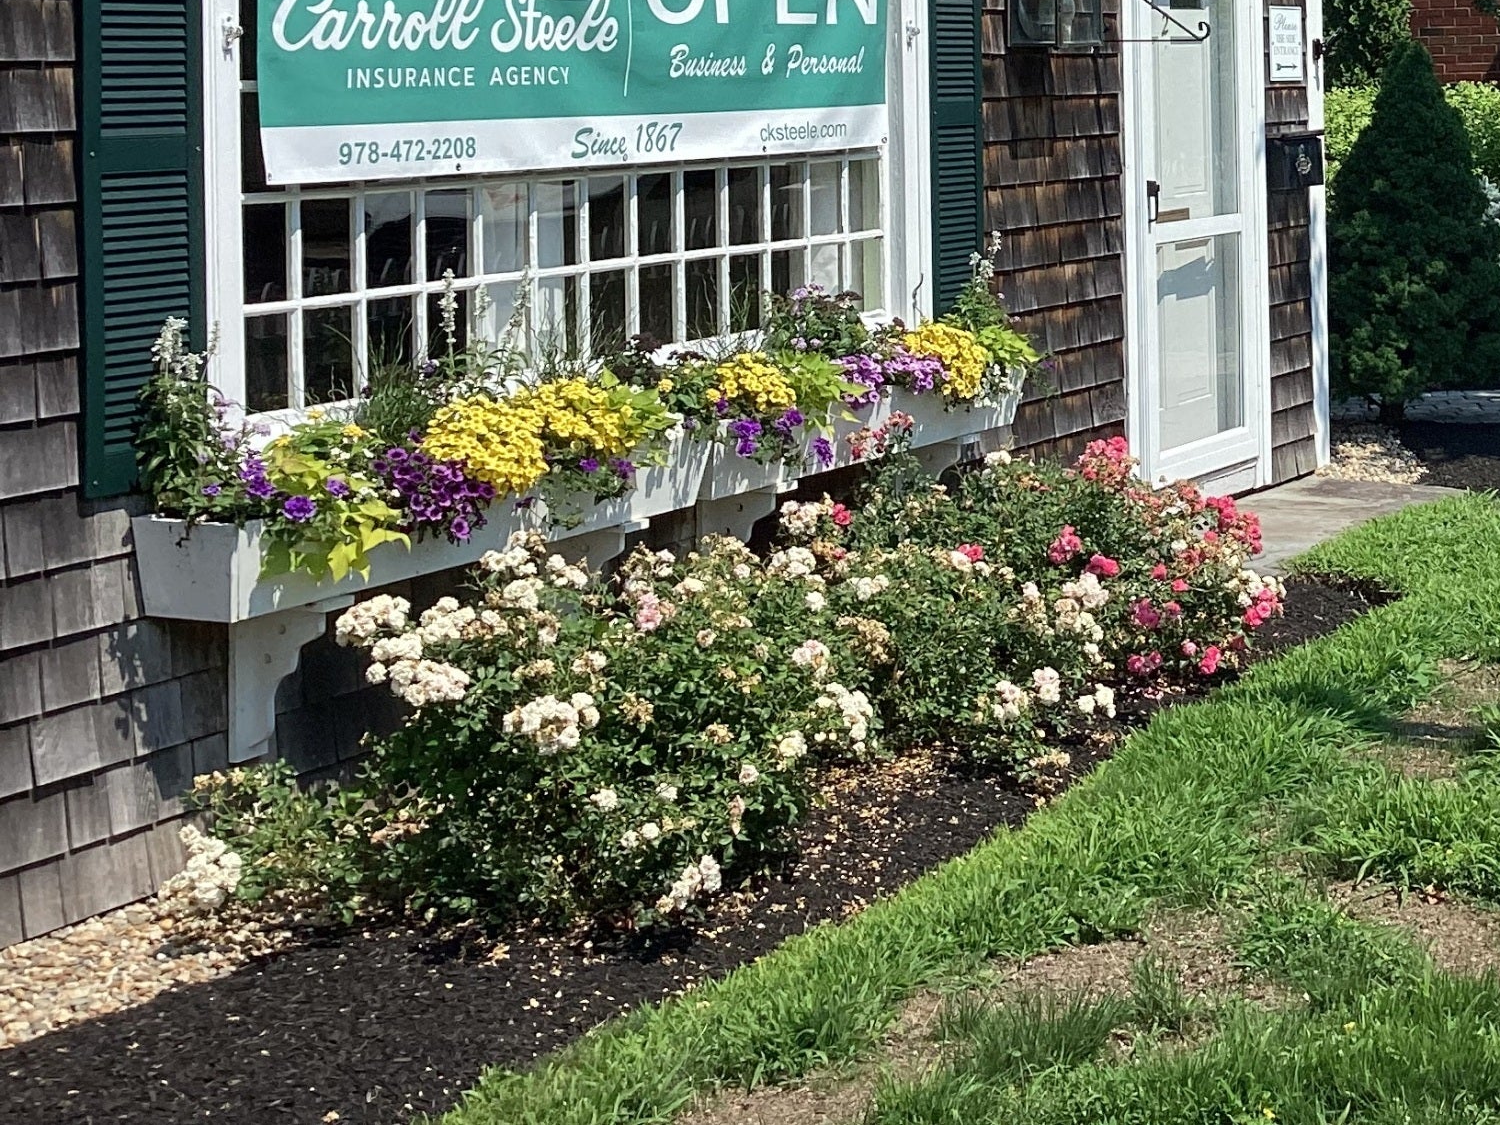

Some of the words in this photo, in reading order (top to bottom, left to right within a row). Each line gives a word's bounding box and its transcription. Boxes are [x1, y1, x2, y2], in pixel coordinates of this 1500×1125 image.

[1273, 12, 1297, 31] Please
[669, 43, 747, 79] Business
[761, 42, 776, 75] &
[786, 43, 866, 79] Personal
[347, 66, 476, 89] INSURANCE
[490, 65, 571, 86] AGENCY
[571, 127, 627, 160] Since
[635, 121, 683, 154] 1867
[760, 121, 848, 143] cksteele.com
[339, 136, 477, 165] 978-472-2208
